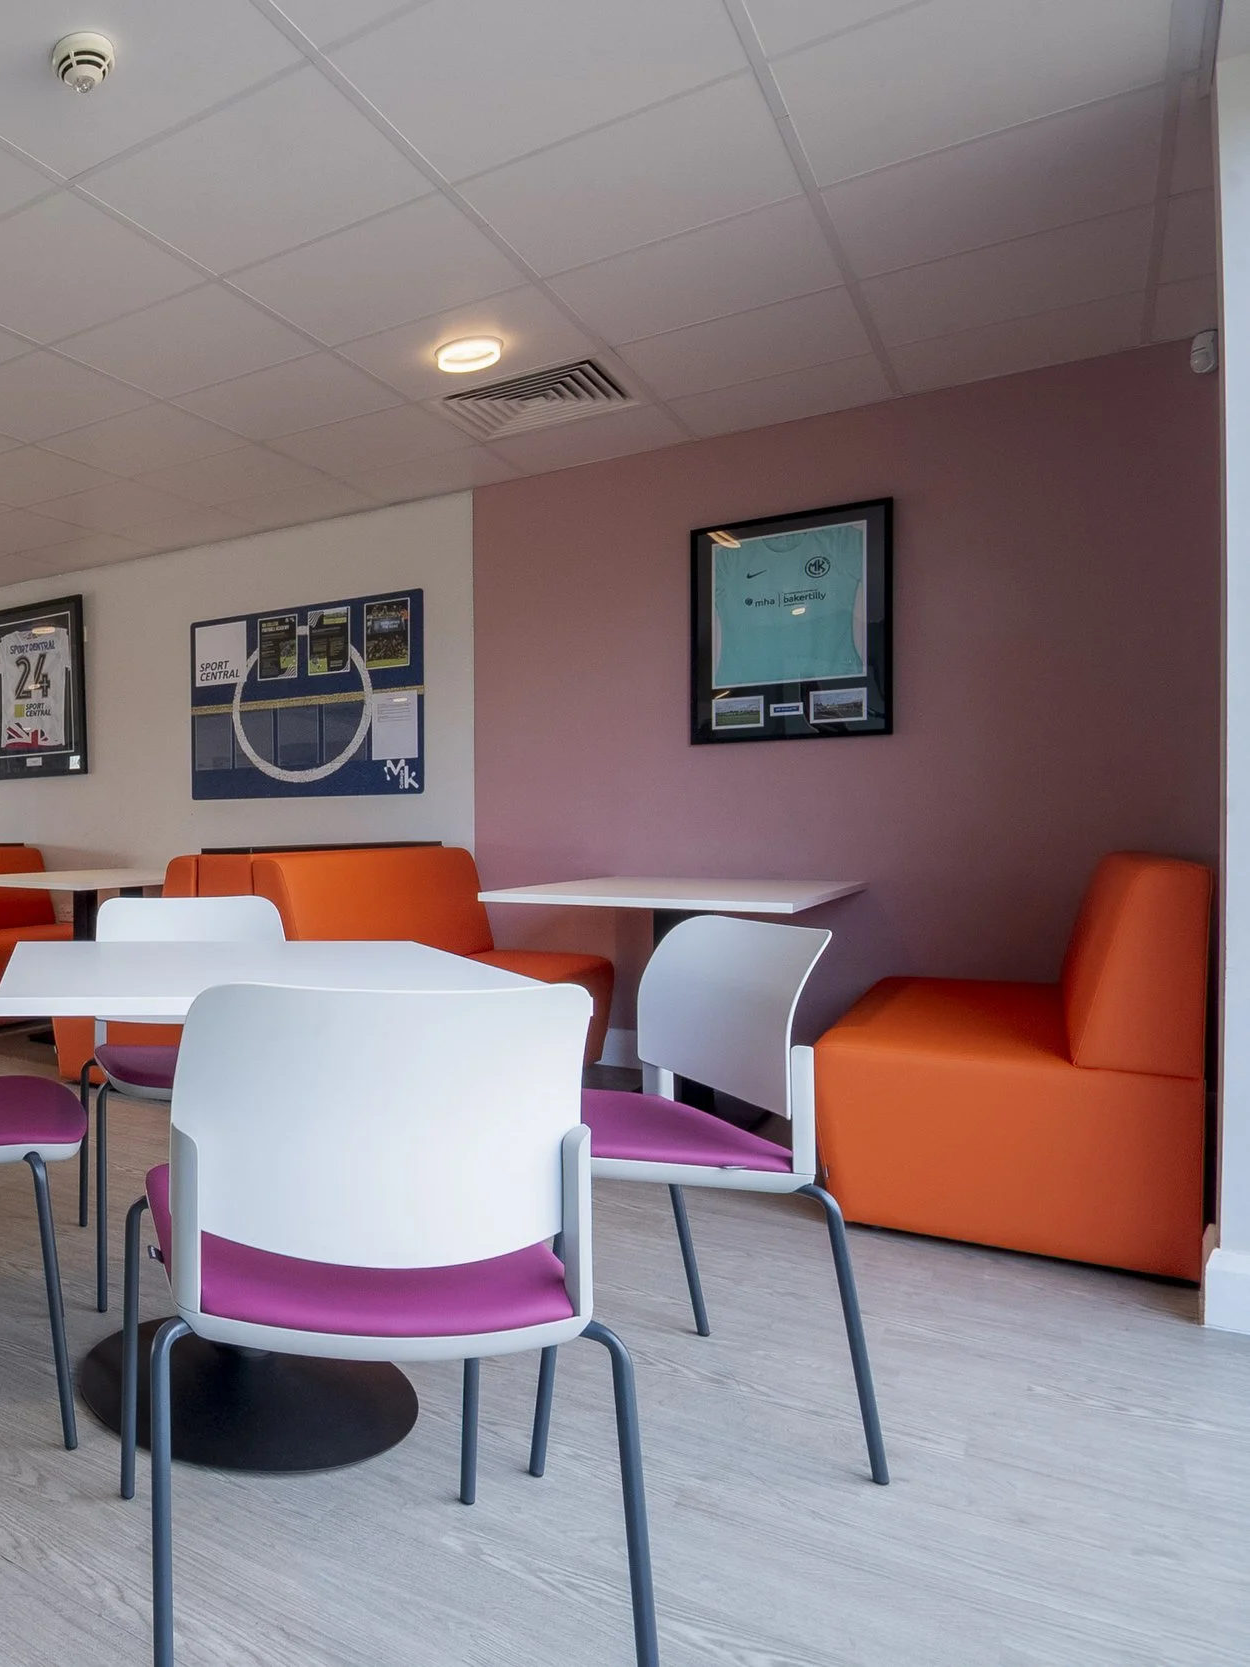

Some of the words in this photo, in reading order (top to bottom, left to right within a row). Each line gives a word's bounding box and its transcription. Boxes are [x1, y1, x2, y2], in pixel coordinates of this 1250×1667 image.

[755, 598, 775, 608] mha
[199, 660, 230, 672] SPORT
[15, 654, 50, 700] 24
[200, 669, 240, 682] CENTRAL
[25, 703, 44, 711] SPORT
